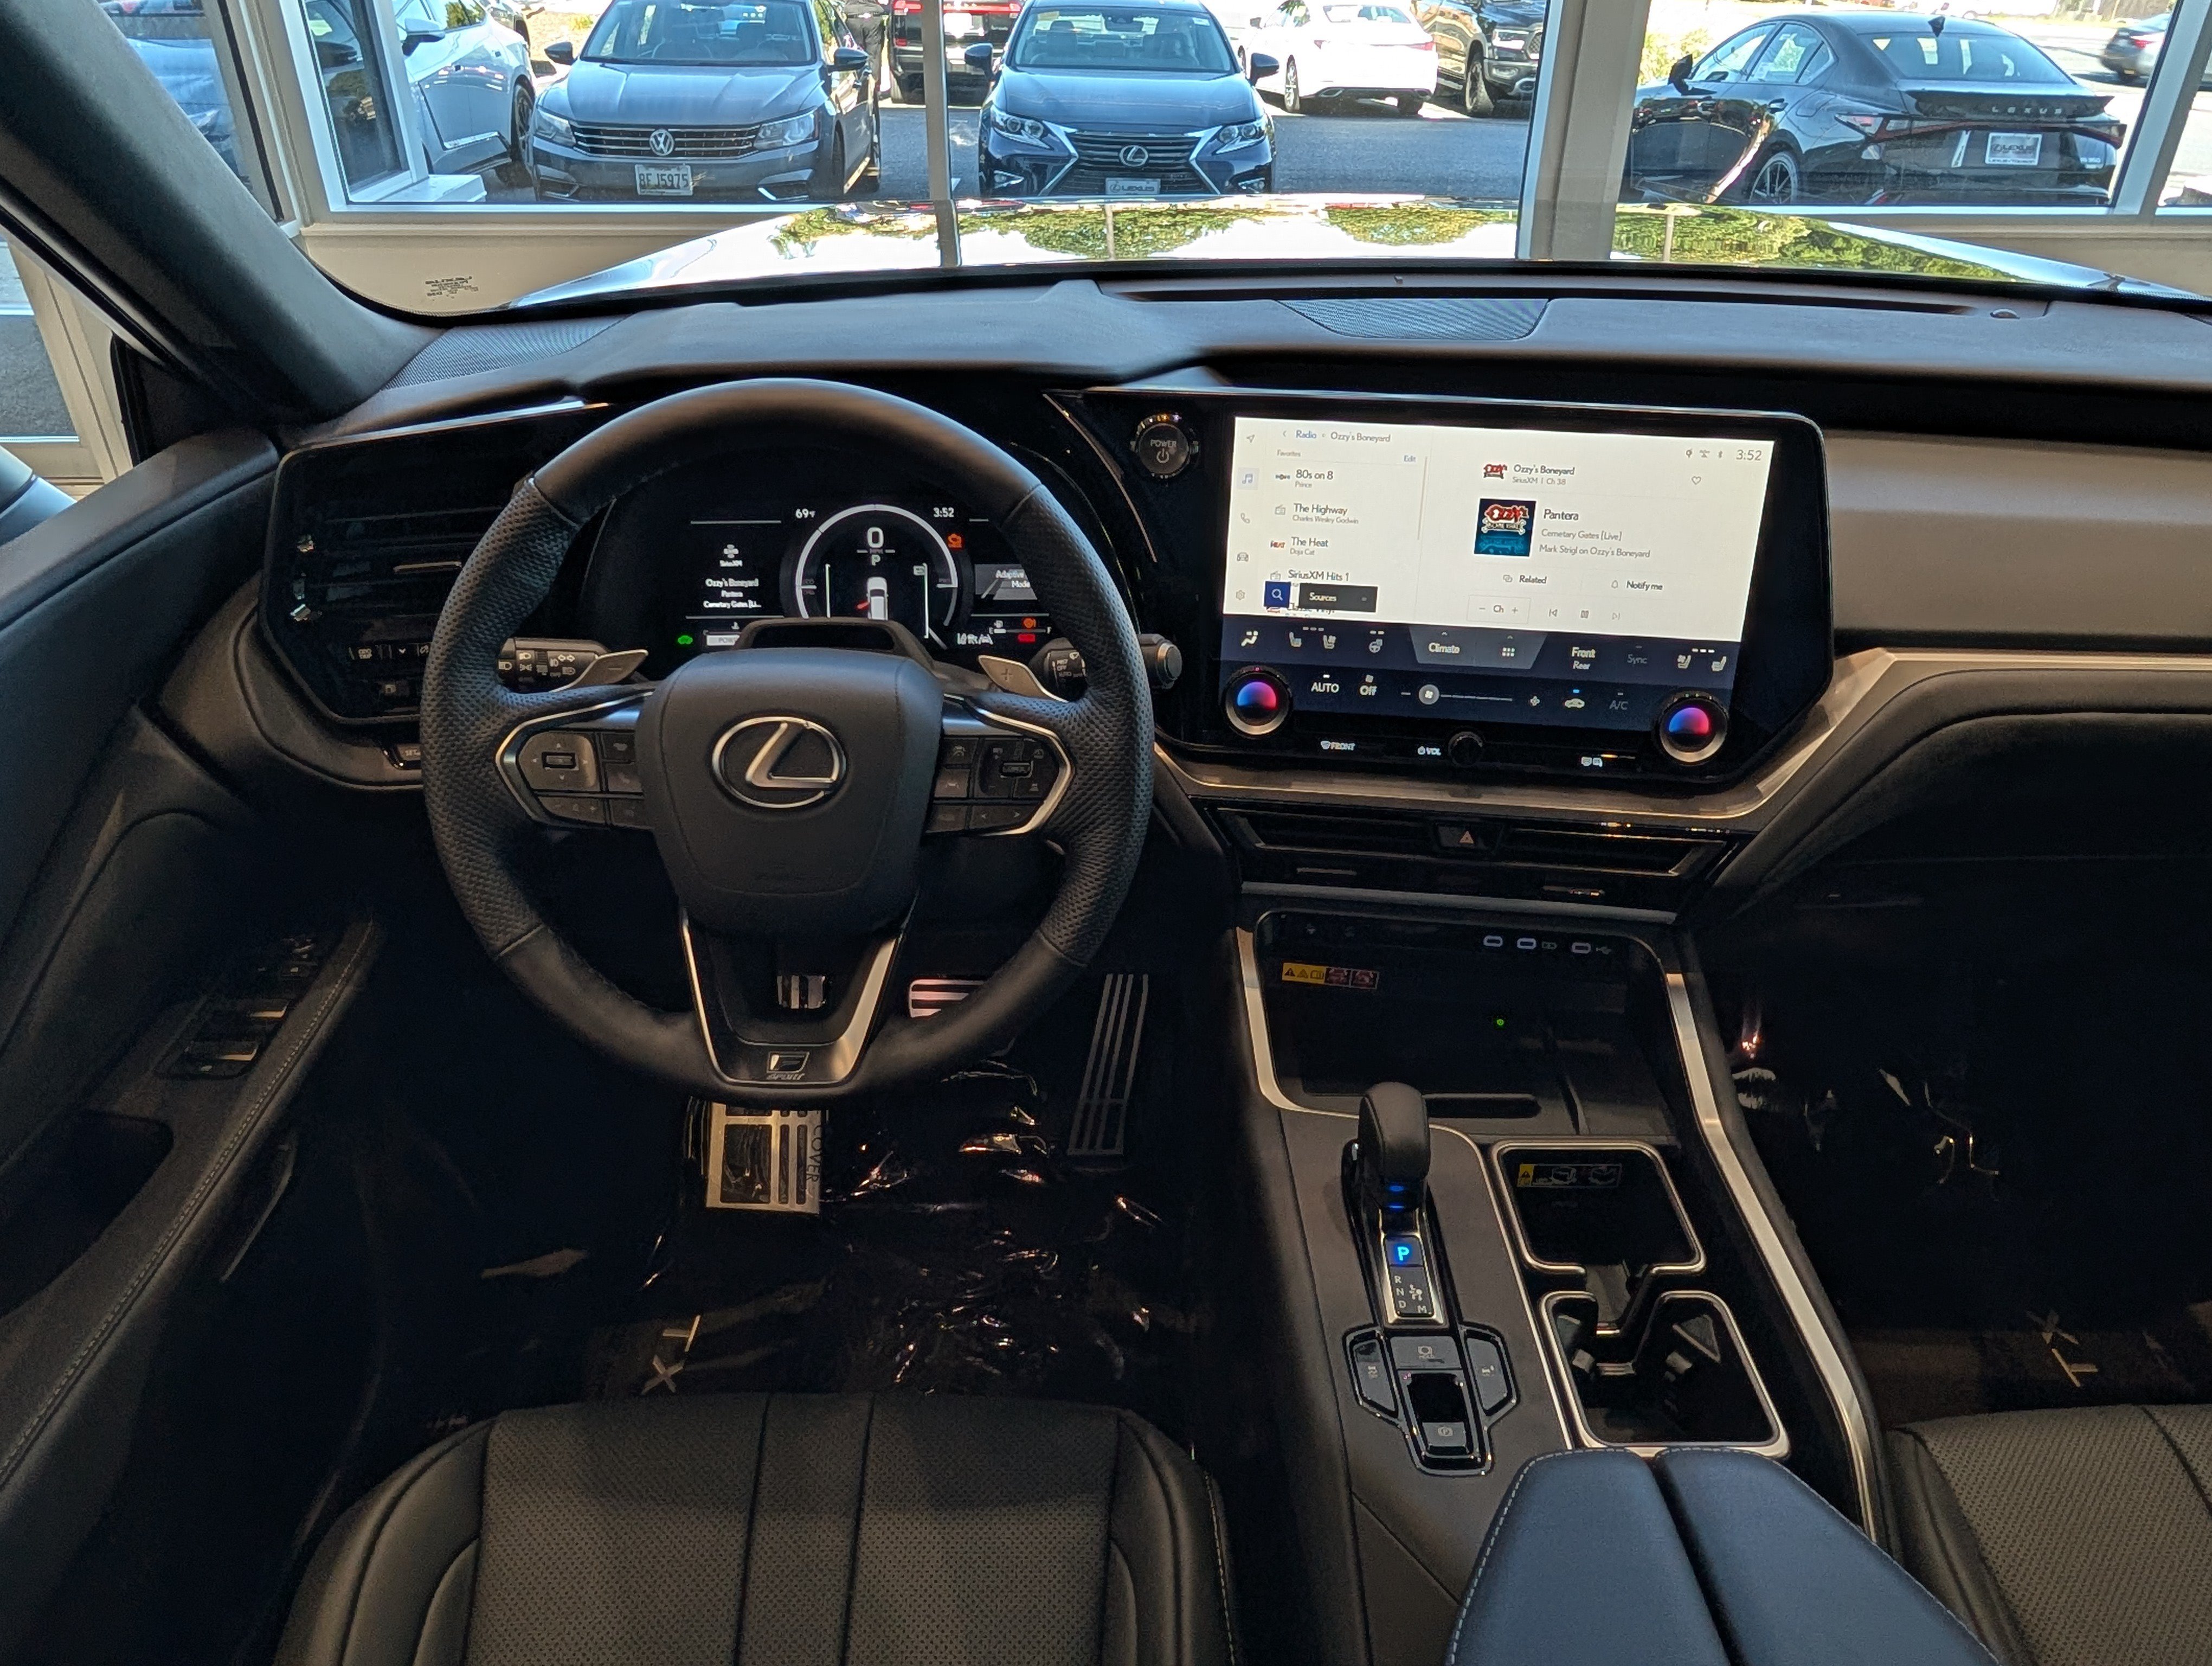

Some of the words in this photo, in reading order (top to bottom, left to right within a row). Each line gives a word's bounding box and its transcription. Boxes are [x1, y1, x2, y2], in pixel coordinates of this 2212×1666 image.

[1991, 106, 2062, 114] LEXUS
[1296, 430, 1317, 439] Radio
[1330, 432, 1355, 441] Ozzy's
[1356, 433, 1391, 443] Boneyard
[1150, 439, 1177, 447] POWER
[1736, 450, 1762, 461] 3:52
[1296, 469, 1313, 479] 80s
[1327, 471, 1333, 480] 8
[1514, 465, 1539, 475] Ozzy's
[1540, 466, 1575, 476] Boneyard
[1512, 476, 1538, 484] SiriusXM
[933, 507, 954, 518] 3:52
[1293, 503, 1309, 513] The
[1311, 504, 1348, 516] Highway
[1544, 509, 1579, 521] Pantera
[1314, 516, 1334, 524] Wesley
[1578, 531, 1599, 540] Gates
[1291, 536, 1307, 546] The
[1309, 538, 1328, 547] Heat
[1539, 544, 1557, 553] Mark
[1560, 546, 1578, 555] Strigl
[1590, 547, 1614, 558] Ozzy's
[1617, 548, 1650, 558] Boneyard
[871, 554, 881, 566] P
[1288, 569, 1324, 580] SiriusXM
[1326, 572, 1343, 581] Hits
[1345, 573, 1349, 581] 1
[1519, 574, 1547, 584] Related
[1626, 580, 1650, 592] Notify
[1309, 592, 1337, 602] Sources
[1493, 605, 1504, 613] Ch
[1429, 642, 1460, 653] Climate
[1572, 647, 1596, 658] Front
[1627, 654, 1648, 665] Sync
[1573, 661, 1590, 670] Rear
[1311, 683, 1340, 693] AUTO
[1609, 700, 1629, 710] A/C
[1330, 742, 1355, 751] FRONT
[1426, 747, 1442, 756] VOL
[806, 1125, 822, 1183] COVER
[1397, 1246, 1410, 1261] P
[1394, 1276, 1402, 1284] R
[1396, 1288, 1404, 1296] N
[1417, 1305, 1427, 1313] M
